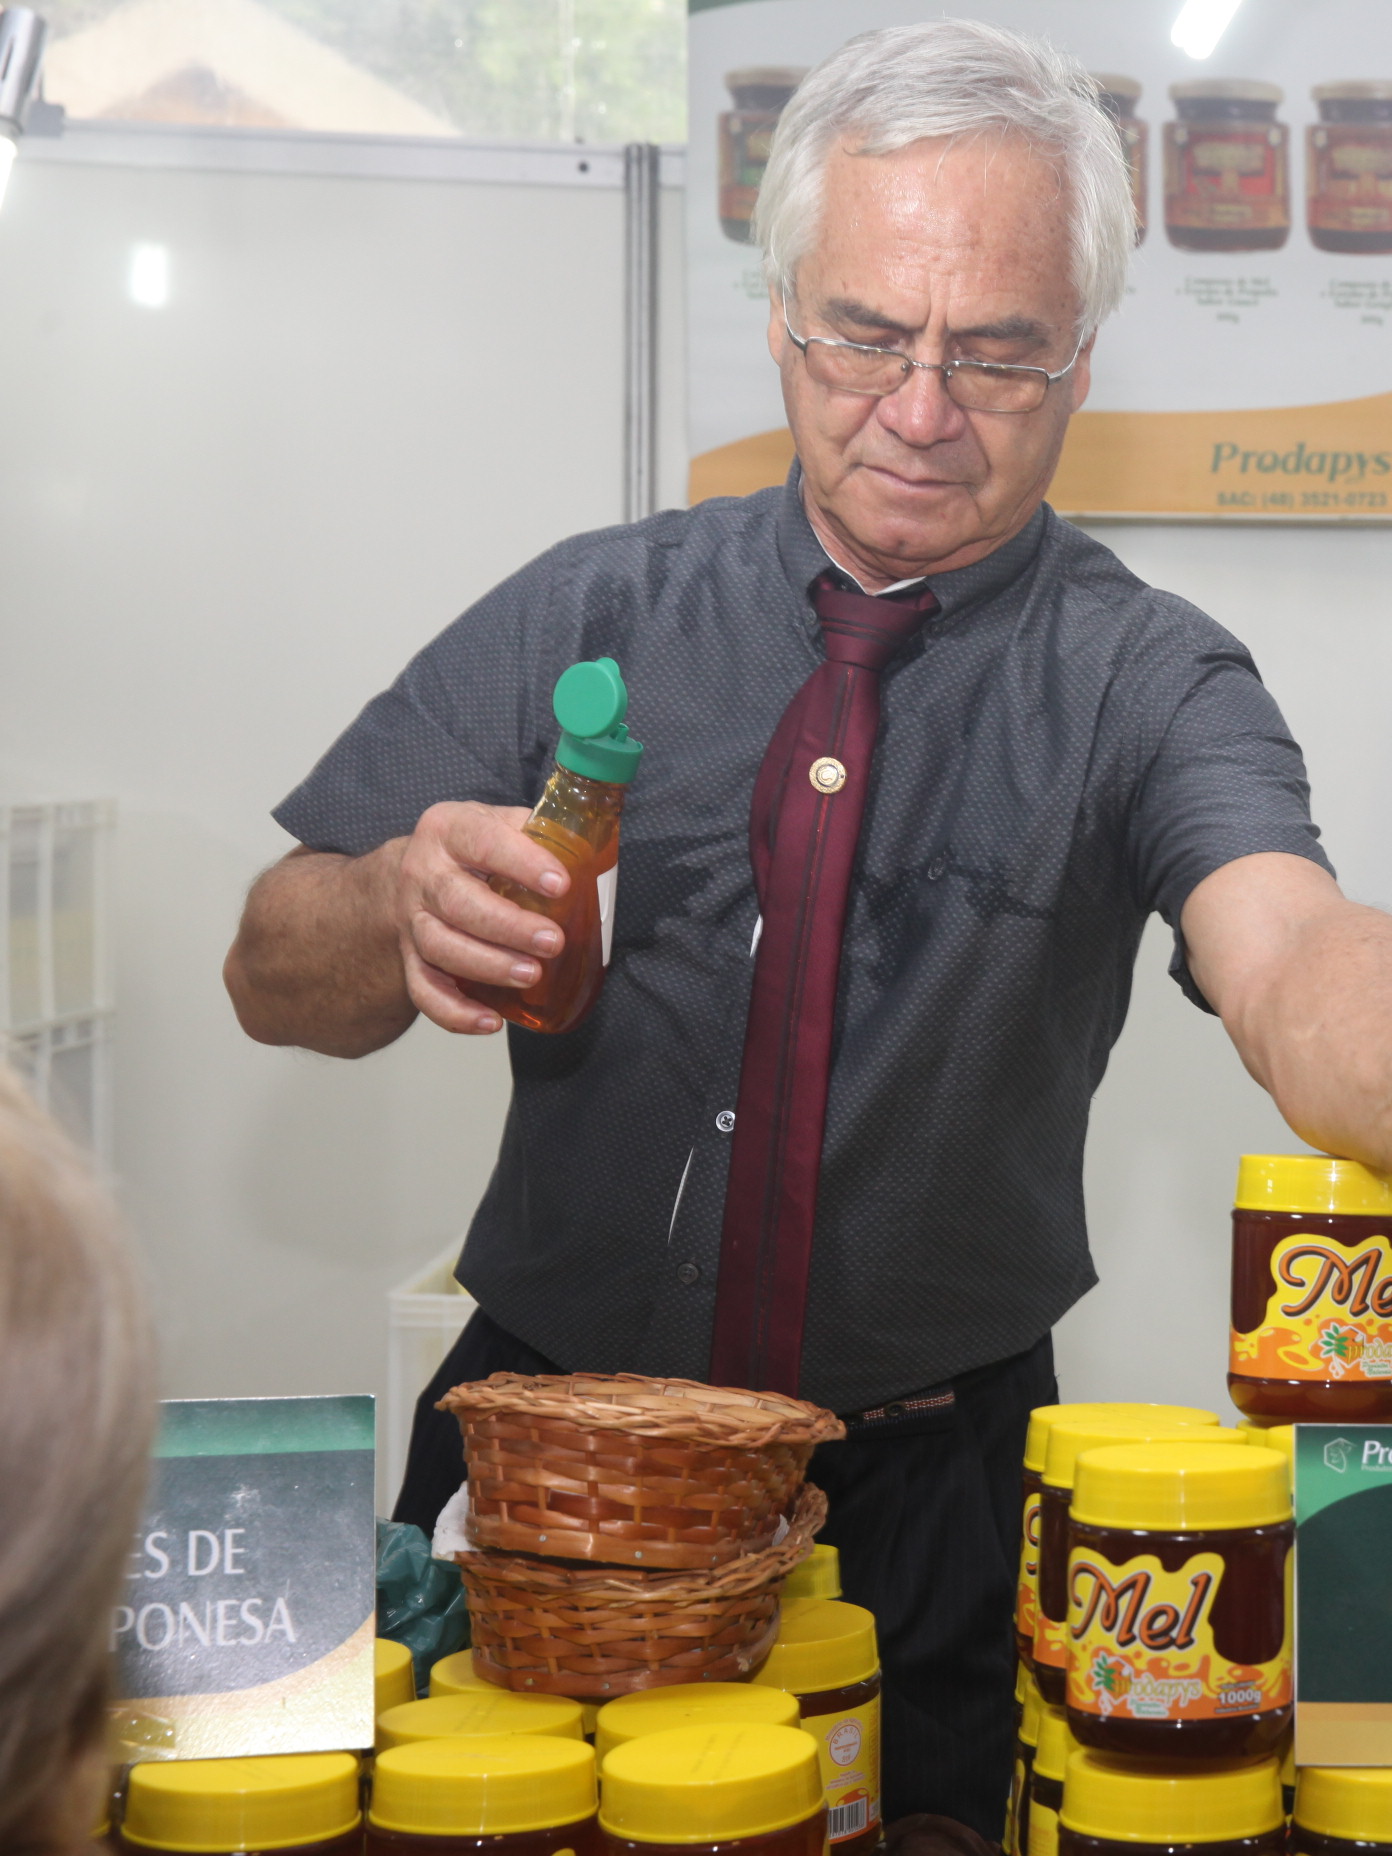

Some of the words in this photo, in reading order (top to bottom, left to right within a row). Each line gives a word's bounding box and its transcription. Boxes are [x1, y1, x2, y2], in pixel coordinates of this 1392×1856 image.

[1210, 441, 1392, 484] Prodapys
[187, 1528, 246, 1576] DE
[1068, 1560, 1212, 1652] Mel
[1219, 1689, 1261, 1704] 1000g
